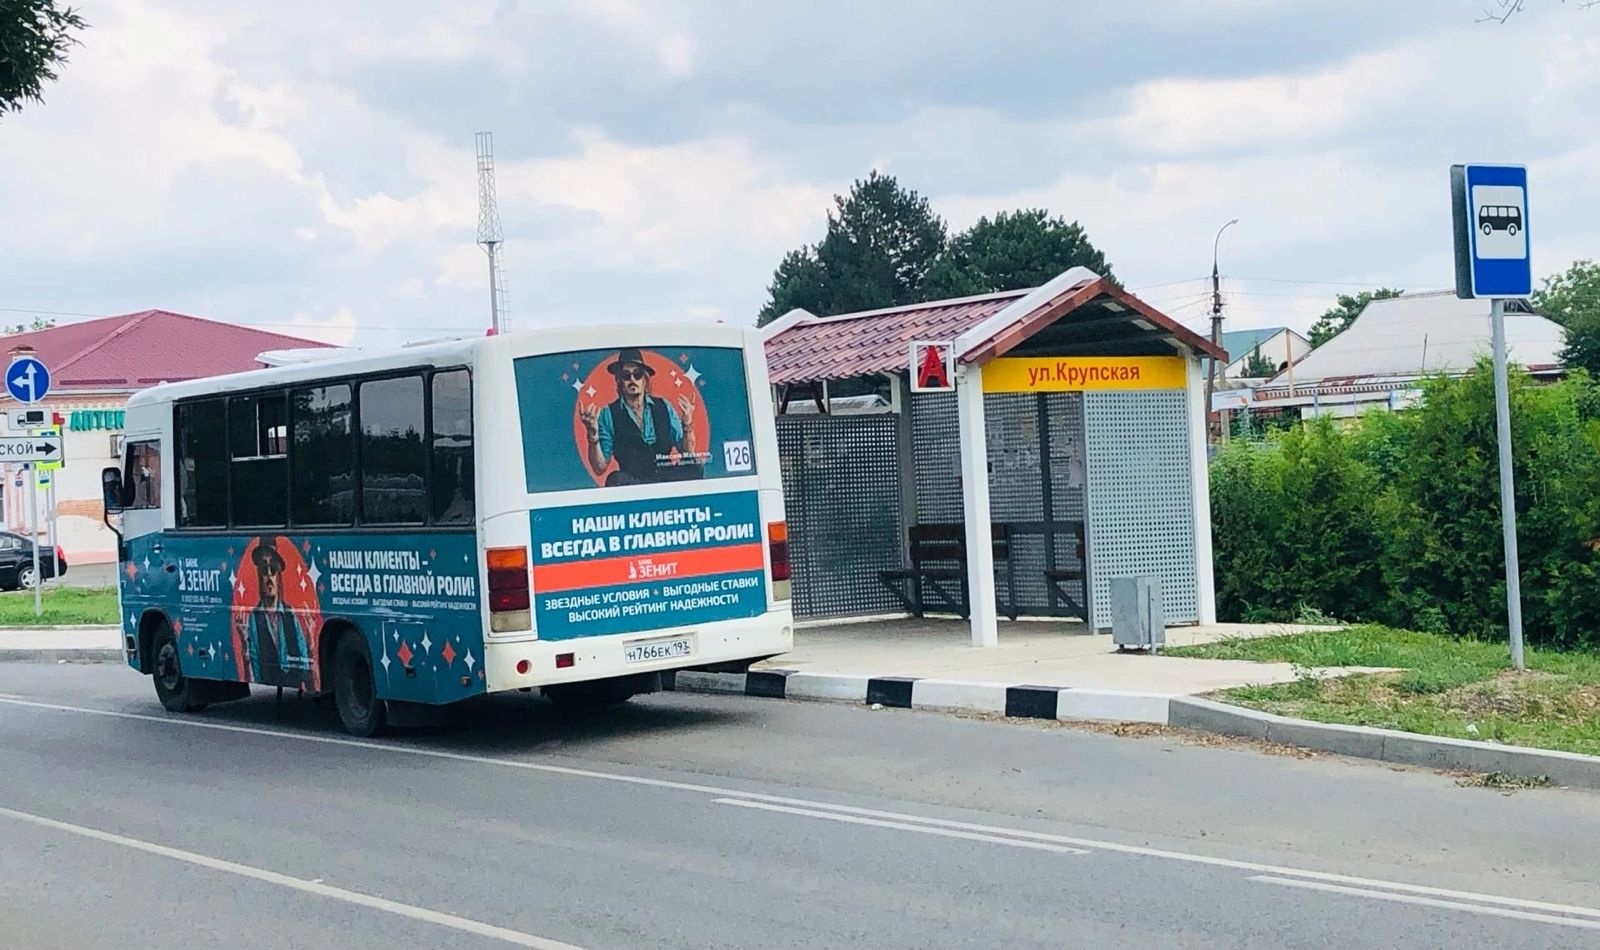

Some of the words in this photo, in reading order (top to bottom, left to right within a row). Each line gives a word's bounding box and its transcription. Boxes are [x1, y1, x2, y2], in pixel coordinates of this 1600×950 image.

[1028, 362, 1141, 386] ул.Крупская
[726, 446, 750, 466] 126
[572, 514, 625, 535] НАШИ
[628, 507, 711, 529] КЛИЕНТЫ
[541, 540, 607, 559] ВСЕГДА
[609, 537, 621, 552] В
[623, 525, 701, 551] ГЛАВНОЙ
[704, 523, 755, 543] РОЛИ!
[329, 550, 362, 569] НАШИ
[364, 551, 420, 570] КЛИЕНТЫ
[638, 562, 679, 579] ЗЕНИТ
[186, 569, 221, 592] ЗЕНИТ
[330, 573, 373, 596] ВСЕГДА
[373, 575, 382, 593] В
[382, 570, 435, 595] ГЛАВНОЙ
[437, 576, 475, 597] РОЛИ!
[544, 593, 601, 611] ЗВЕЗДНЫЕ
[602, 588, 650, 604] УСЛОВИЯ
[663, 580, 720, 597] ВЫГОДНЫЕ
[721, 577, 759, 591] СТАВКИ
[568, 603, 621, 623] ВЫСОКИЙ
[622, 599, 669, 617] РЕЙТИНГ
[670, 593, 739, 612] НАДЕЖНОСТИ
[626, 646, 672, 660] Н766ЕК
